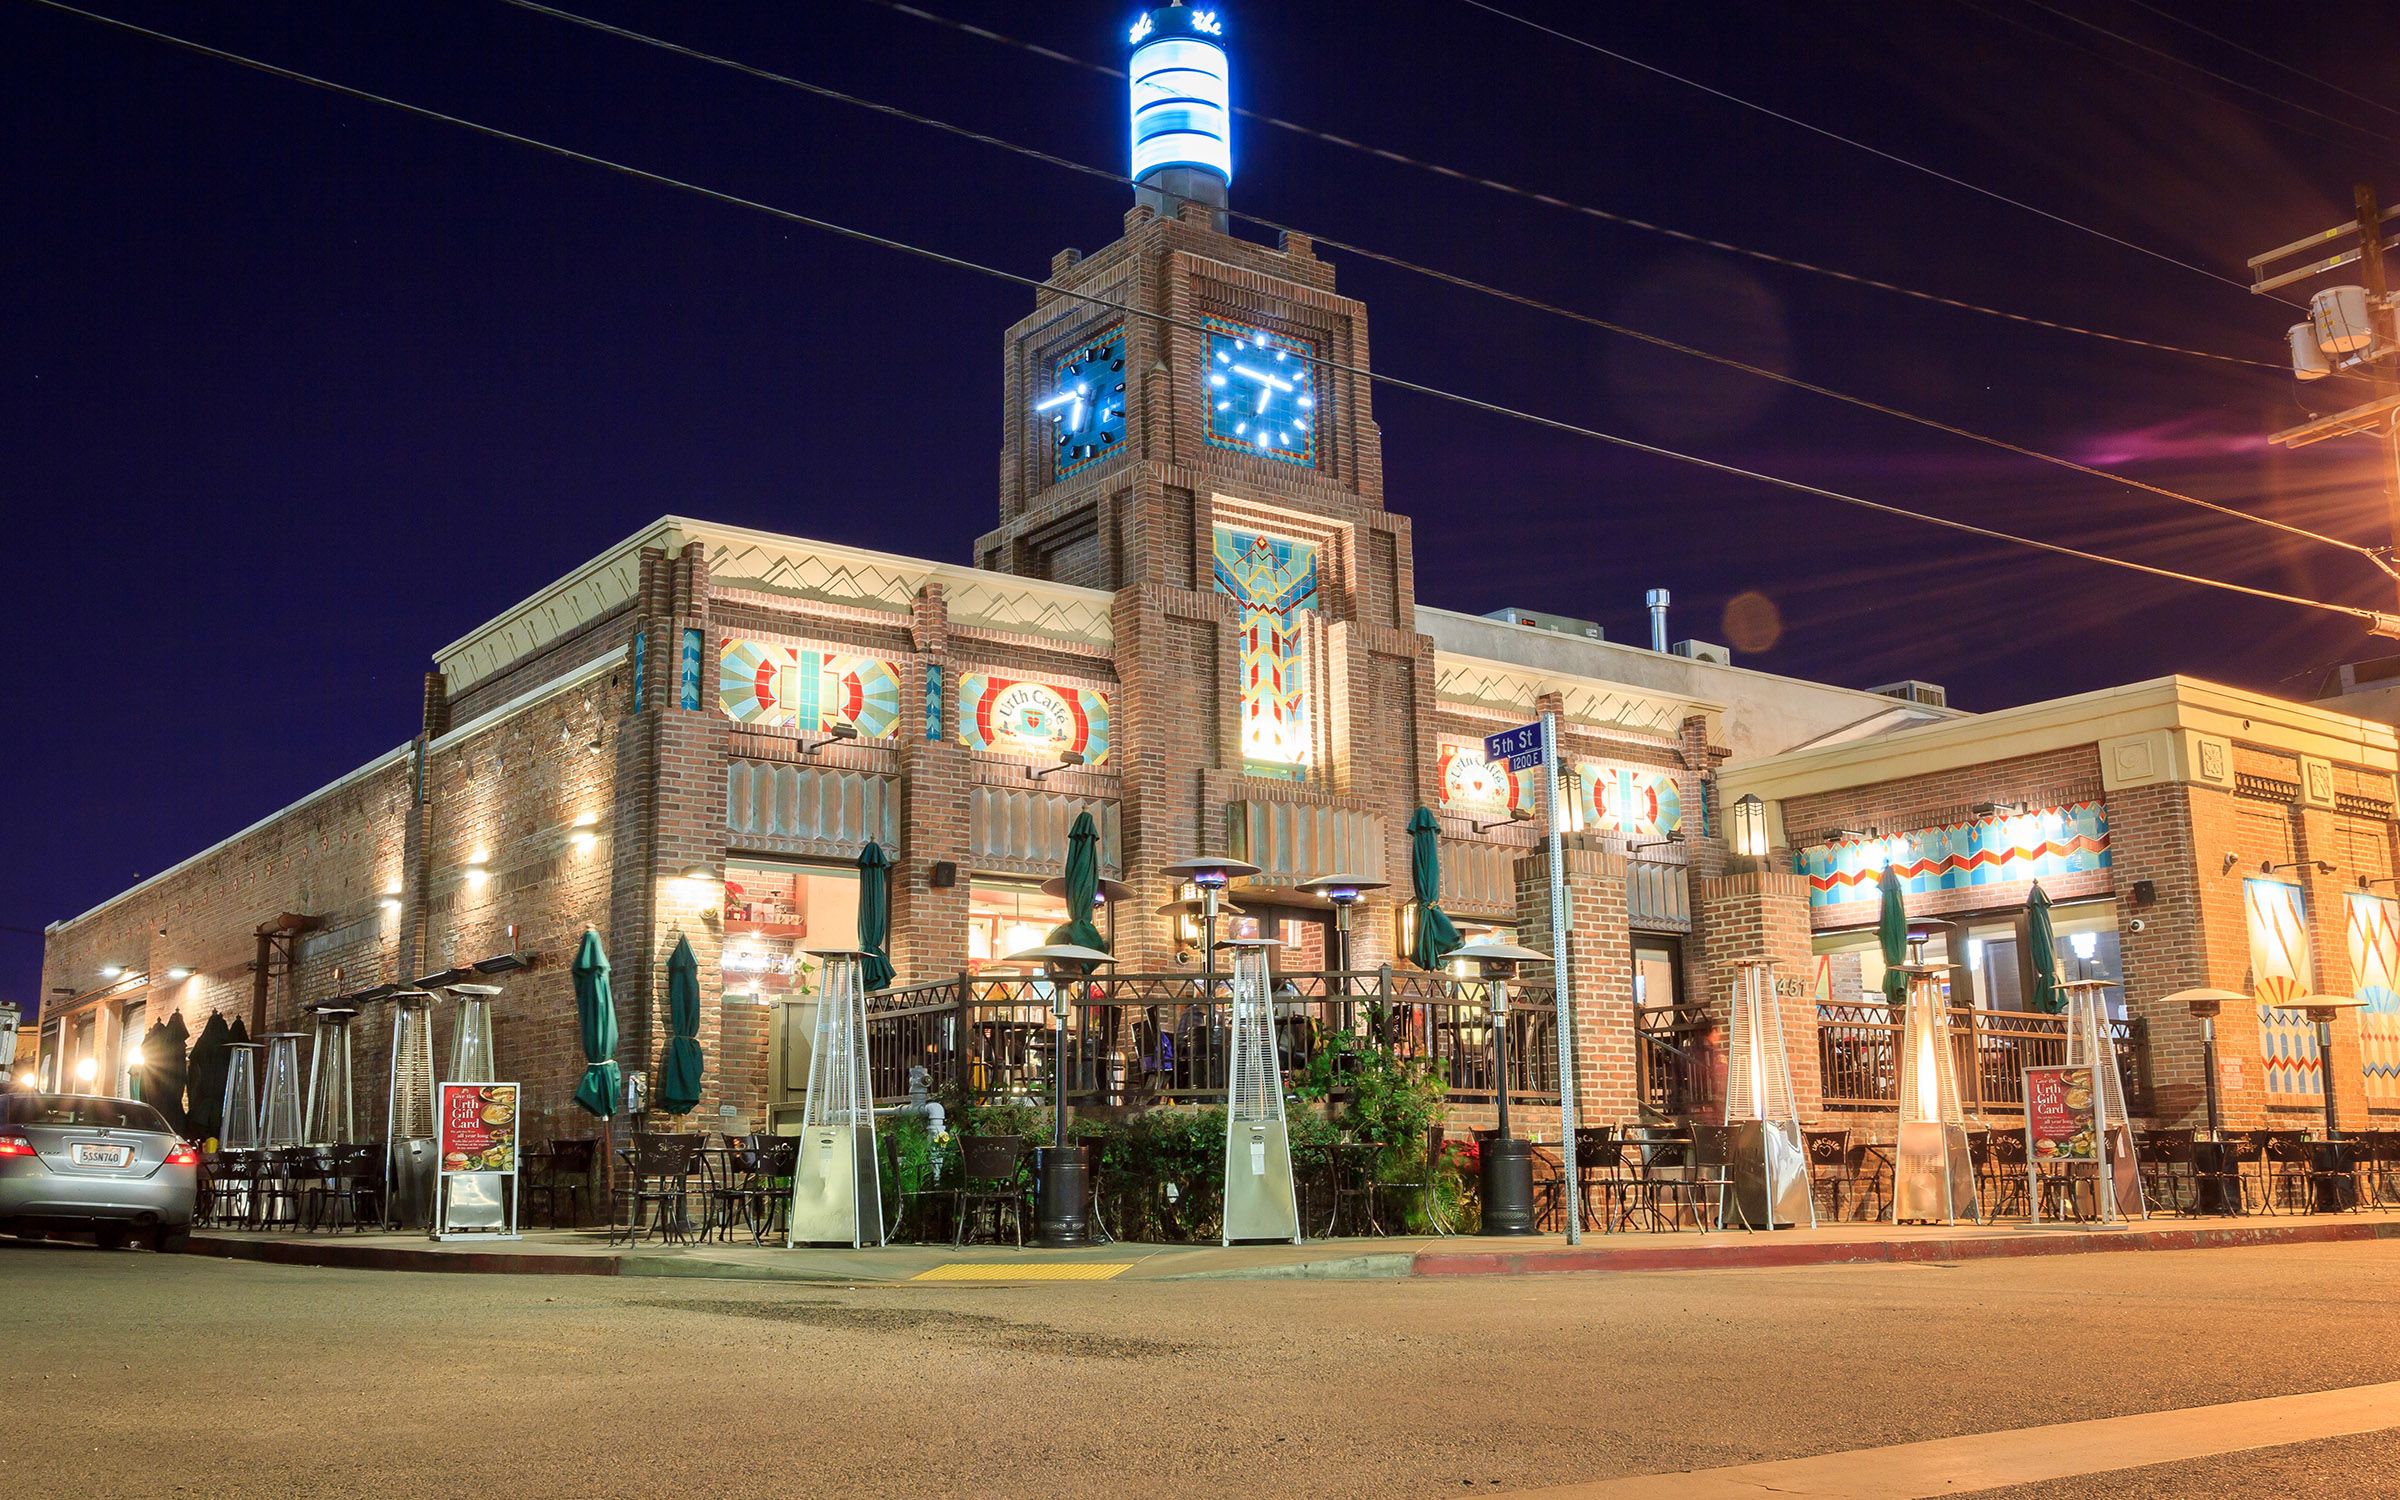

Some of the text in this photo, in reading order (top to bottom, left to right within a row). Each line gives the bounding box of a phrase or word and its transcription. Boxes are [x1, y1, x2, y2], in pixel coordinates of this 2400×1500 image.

[1000, 689, 1068, 725] Urth Caffé
[1492, 729, 1533, 757] 5th St
[1513, 752, 1538, 770] 1200 E
[1776, 978, 1807, 997] 451
[2036, 1083, 2061, 1094] Urth
[452, 1099, 479, 1109] Urth
[2037, 1093, 2058, 1104] Gift
[452, 1108, 474, 1119] Gift
[2038, 1103, 2064, 1114] Card
[451, 1118, 480, 1129] Card
[83, 1151, 119, 1163] 5SSN740
